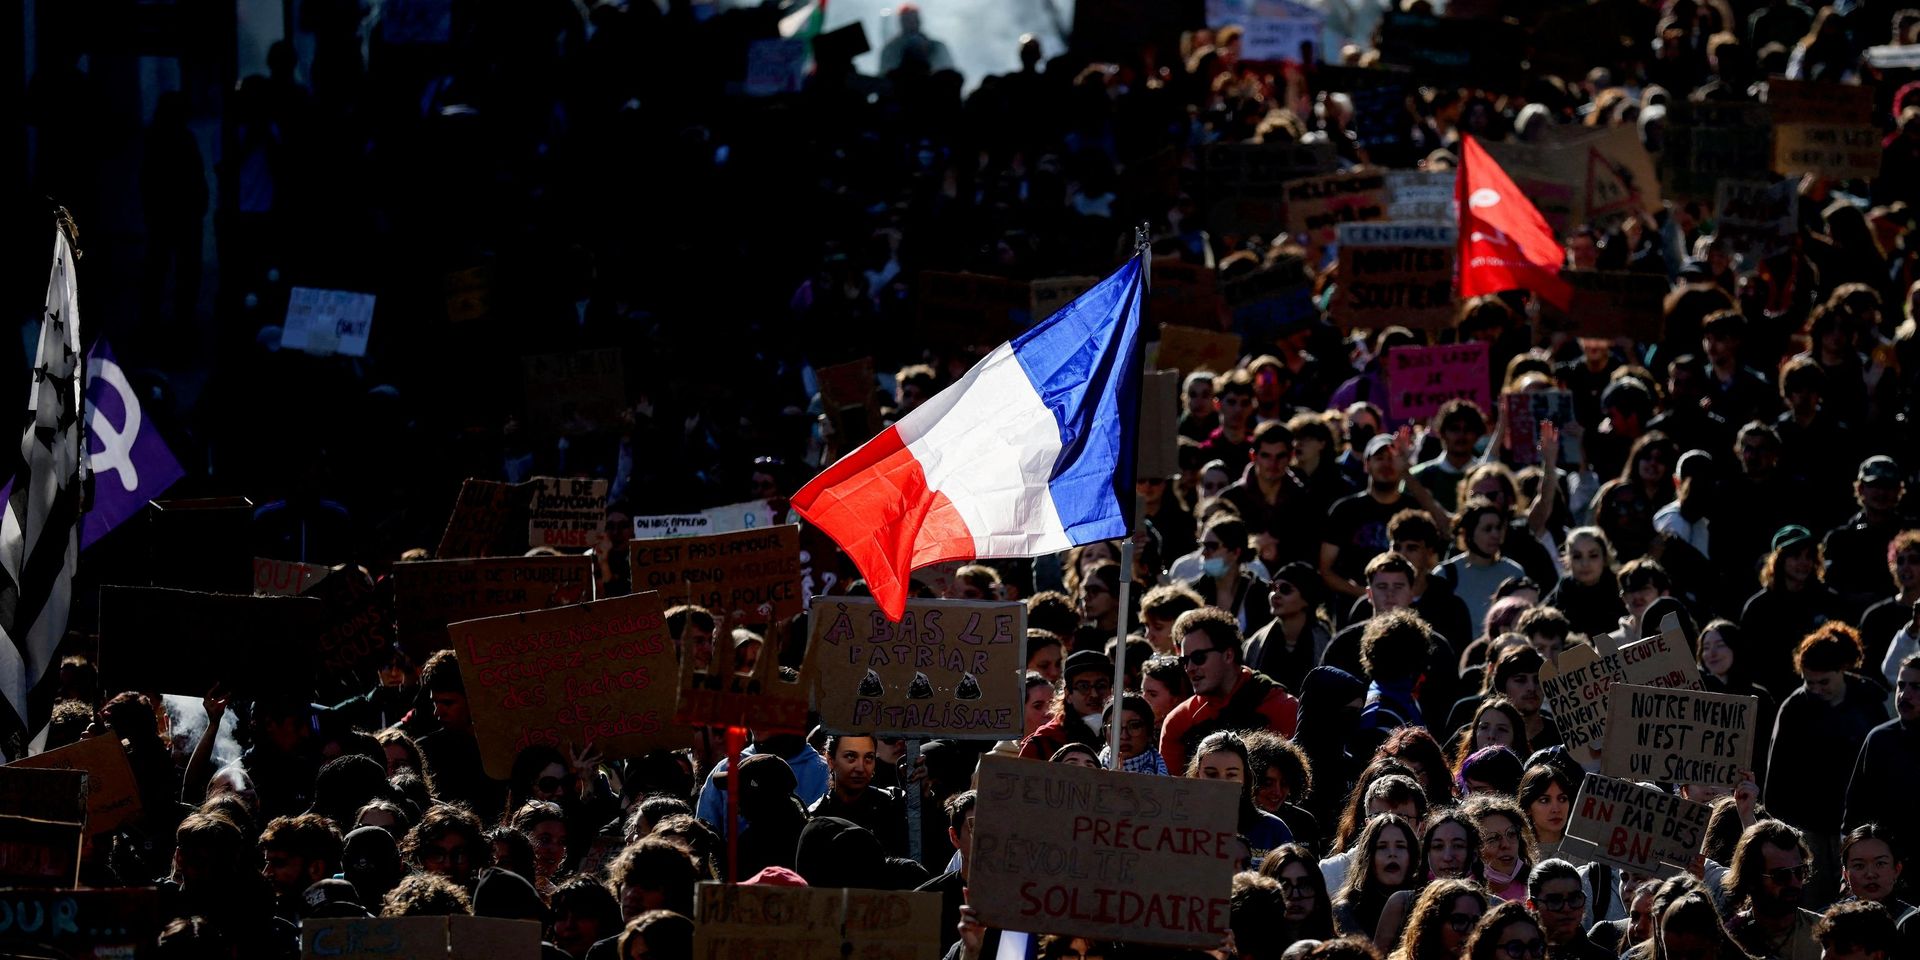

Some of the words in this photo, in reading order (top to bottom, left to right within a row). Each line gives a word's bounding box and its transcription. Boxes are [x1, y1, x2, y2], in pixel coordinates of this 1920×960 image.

[824, 603, 855, 646] À
[867, 609, 945, 646] BAS
[957, 612, 1013, 645] LE
[503, 685, 547, 710] des
[557, 702, 592, 725] et
[1550, 691, 1581, 716] PAS
[1631, 692, 1690, 720] NOTRE
[1693, 695, 1747, 730] AVENIR
[1561, 726, 1590, 752] PAS
[1638, 724, 1693, 751] N'EST
[1700, 730, 1740, 758] PAS
[1630, 754, 1652, 775] UN
[1658, 753, 1738, 785] SACRIFICE
[990, 772, 1190, 822] JEUNESSE
[1585, 775, 1681, 818] REMPLACER
[1683, 803, 1710, 828] LE
[1072, 815, 1233, 860] PRÉCAIRE
[1581, 797, 1614, 823] RN
[1621, 806, 1657, 835] PAR
[1661, 818, 1700, 850] DES
[1606, 826, 1652, 866] BN
[1020, 882, 1231, 934] SOLIDAIRE
